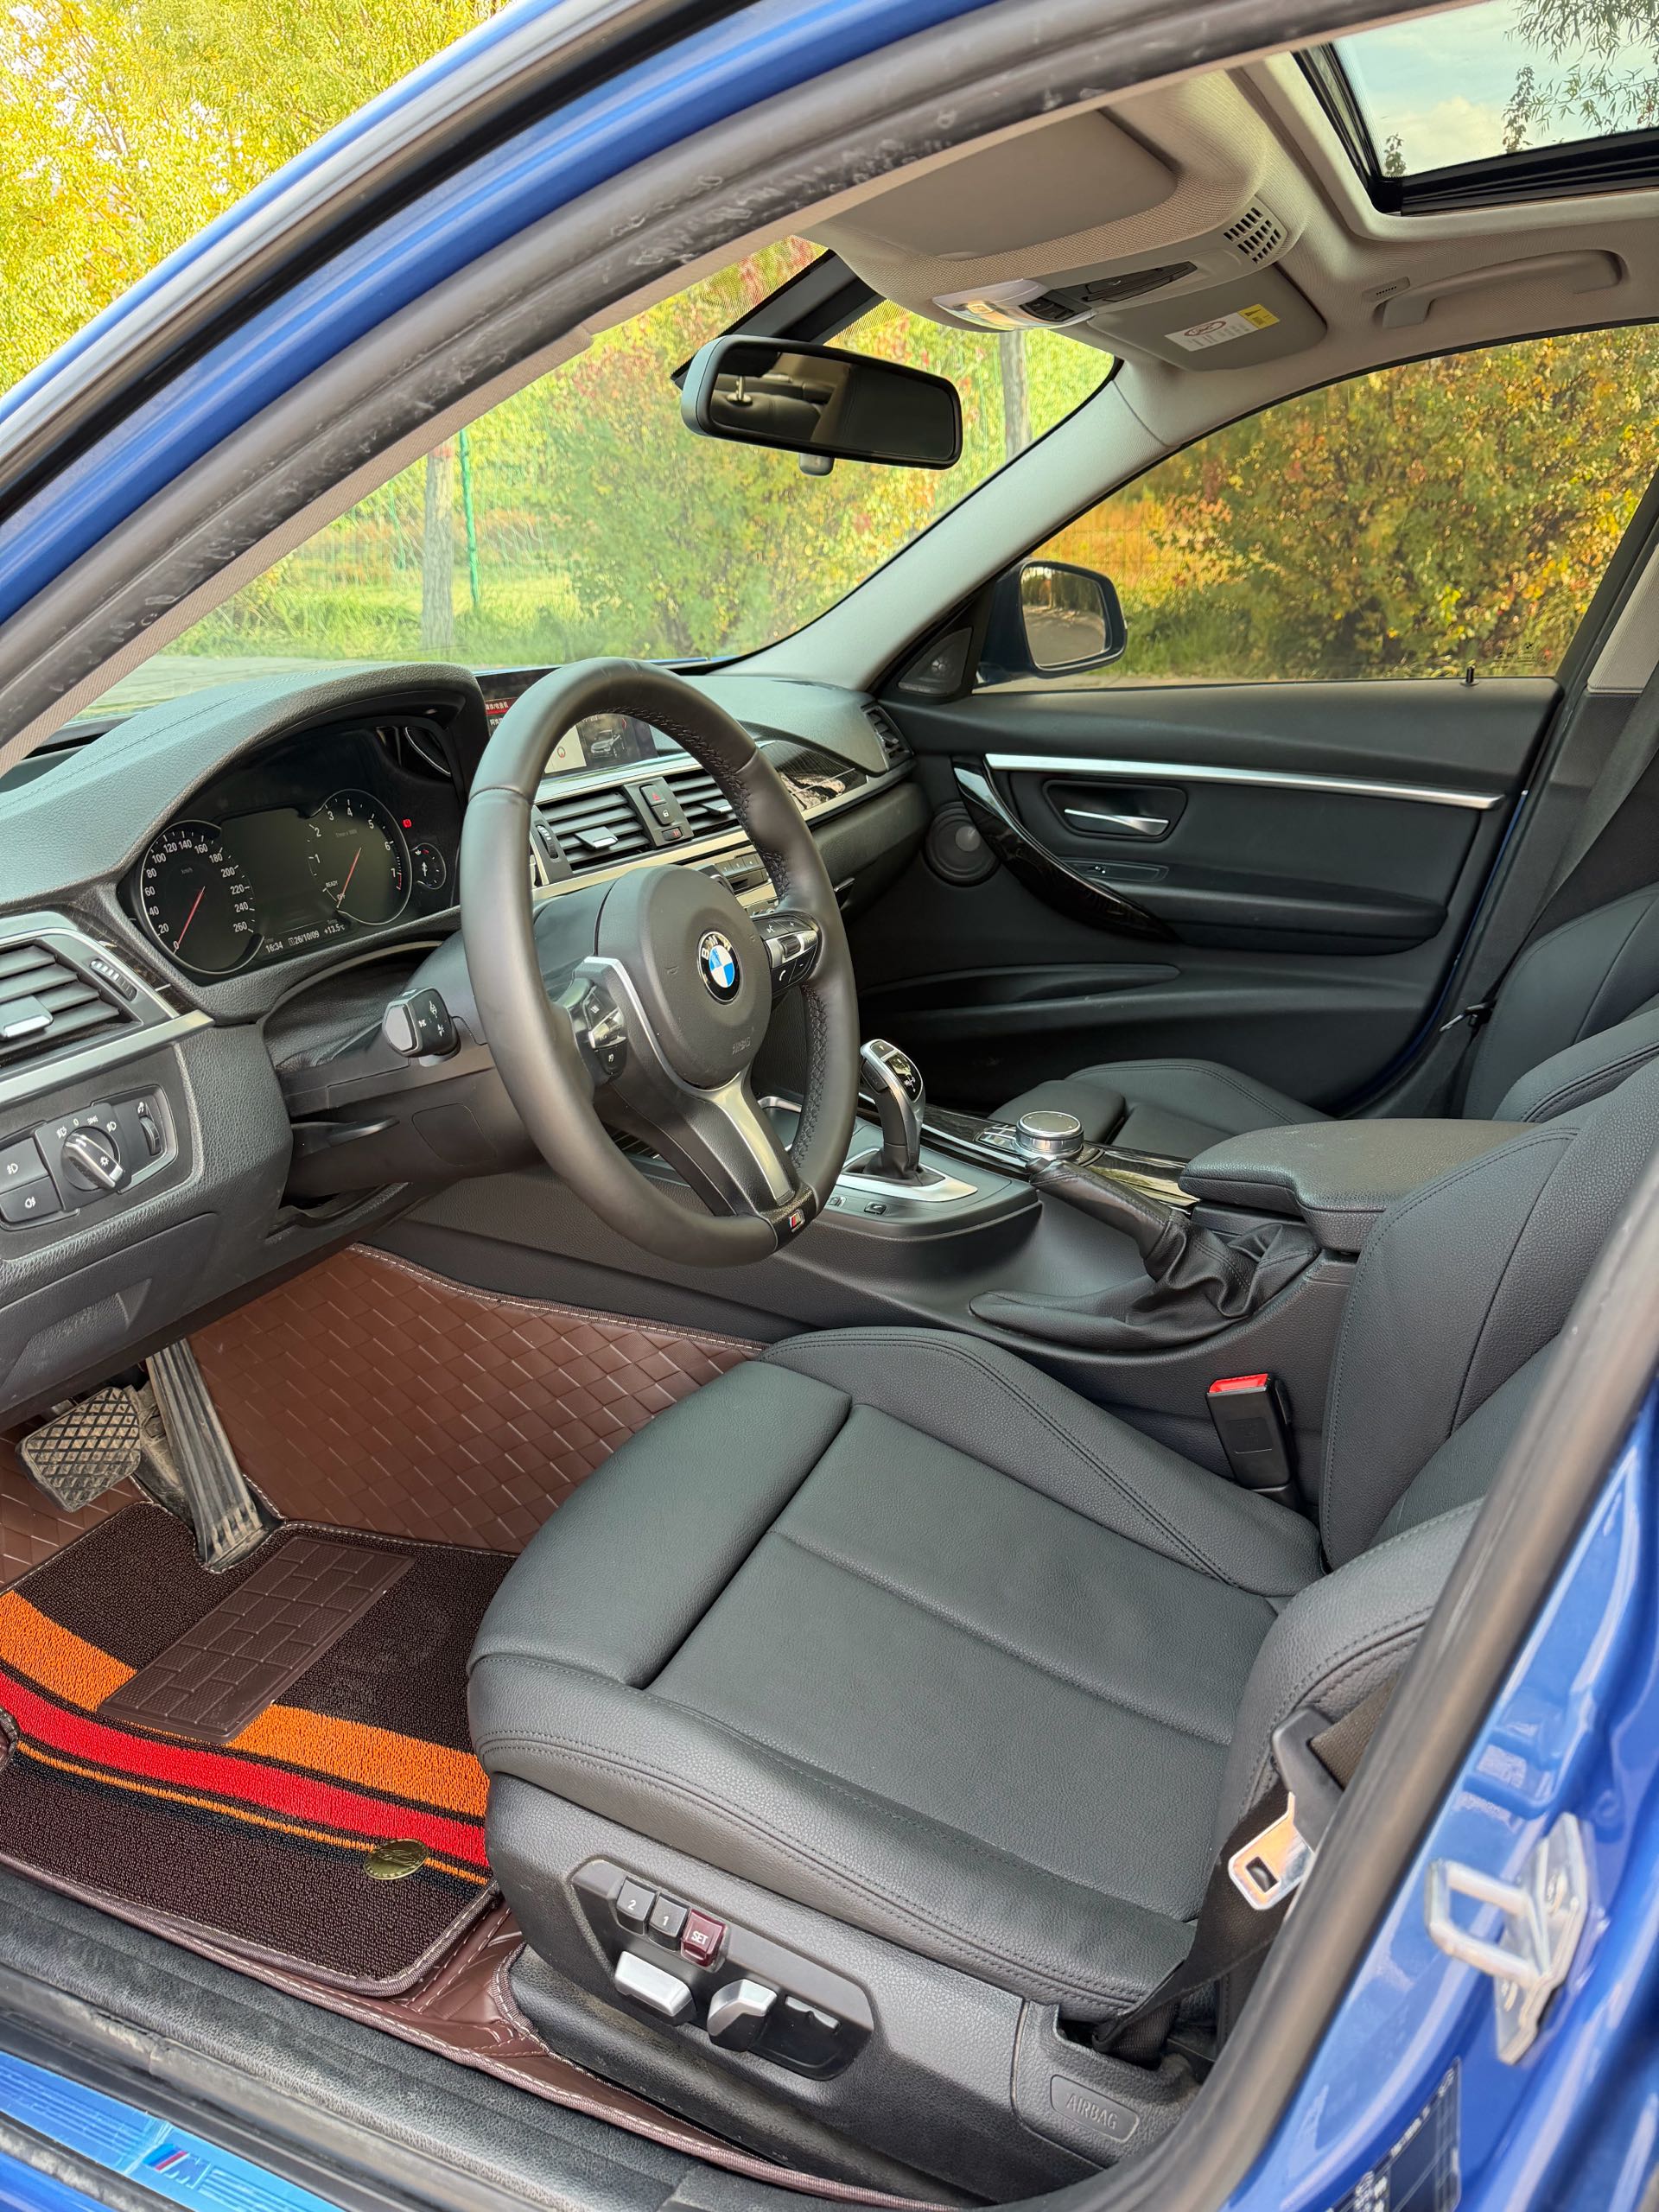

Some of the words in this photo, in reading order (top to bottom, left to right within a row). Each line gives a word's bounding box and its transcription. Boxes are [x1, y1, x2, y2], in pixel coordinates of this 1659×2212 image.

[327, 810, 334, 821] 3
[346, 807, 353, 817] 4
[367, 819, 374, 830] 5
[314, 827, 321, 837] 2
[163, 842, 178, 854] 120
[178, 839, 193, 850] 140
[194, 843, 208, 854] 160
[385, 841, 391, 851] 6
[152, 852, 167, 864] 100
[209, 852, 223, 864] 180
[315, 854, 321, 864] 1
[146, 868, 157, 879] 80
[220, 867, 236, 878] 200
[391, 868, 396, 878] 7
[144, 886, 156, 897] 60
[230, 884, 245, 895] 220
[149, 906, 160, 917] 40
[234, 901, 249, 913] 240
[158, 923, 169, 934] 20
[232, 921, 248, 933] 260
[173, 940, 180, 950] 0
[265, 941, 283, 953] 16:34
[701, 934, 732, 961] BMW
[627, 1899, 637, 1910] 2
[663, 1916, 670, 1927] 1
[690, 1930, 709, 1945] SET
[1065, 2093, 1119, 2131] AIRBAG
